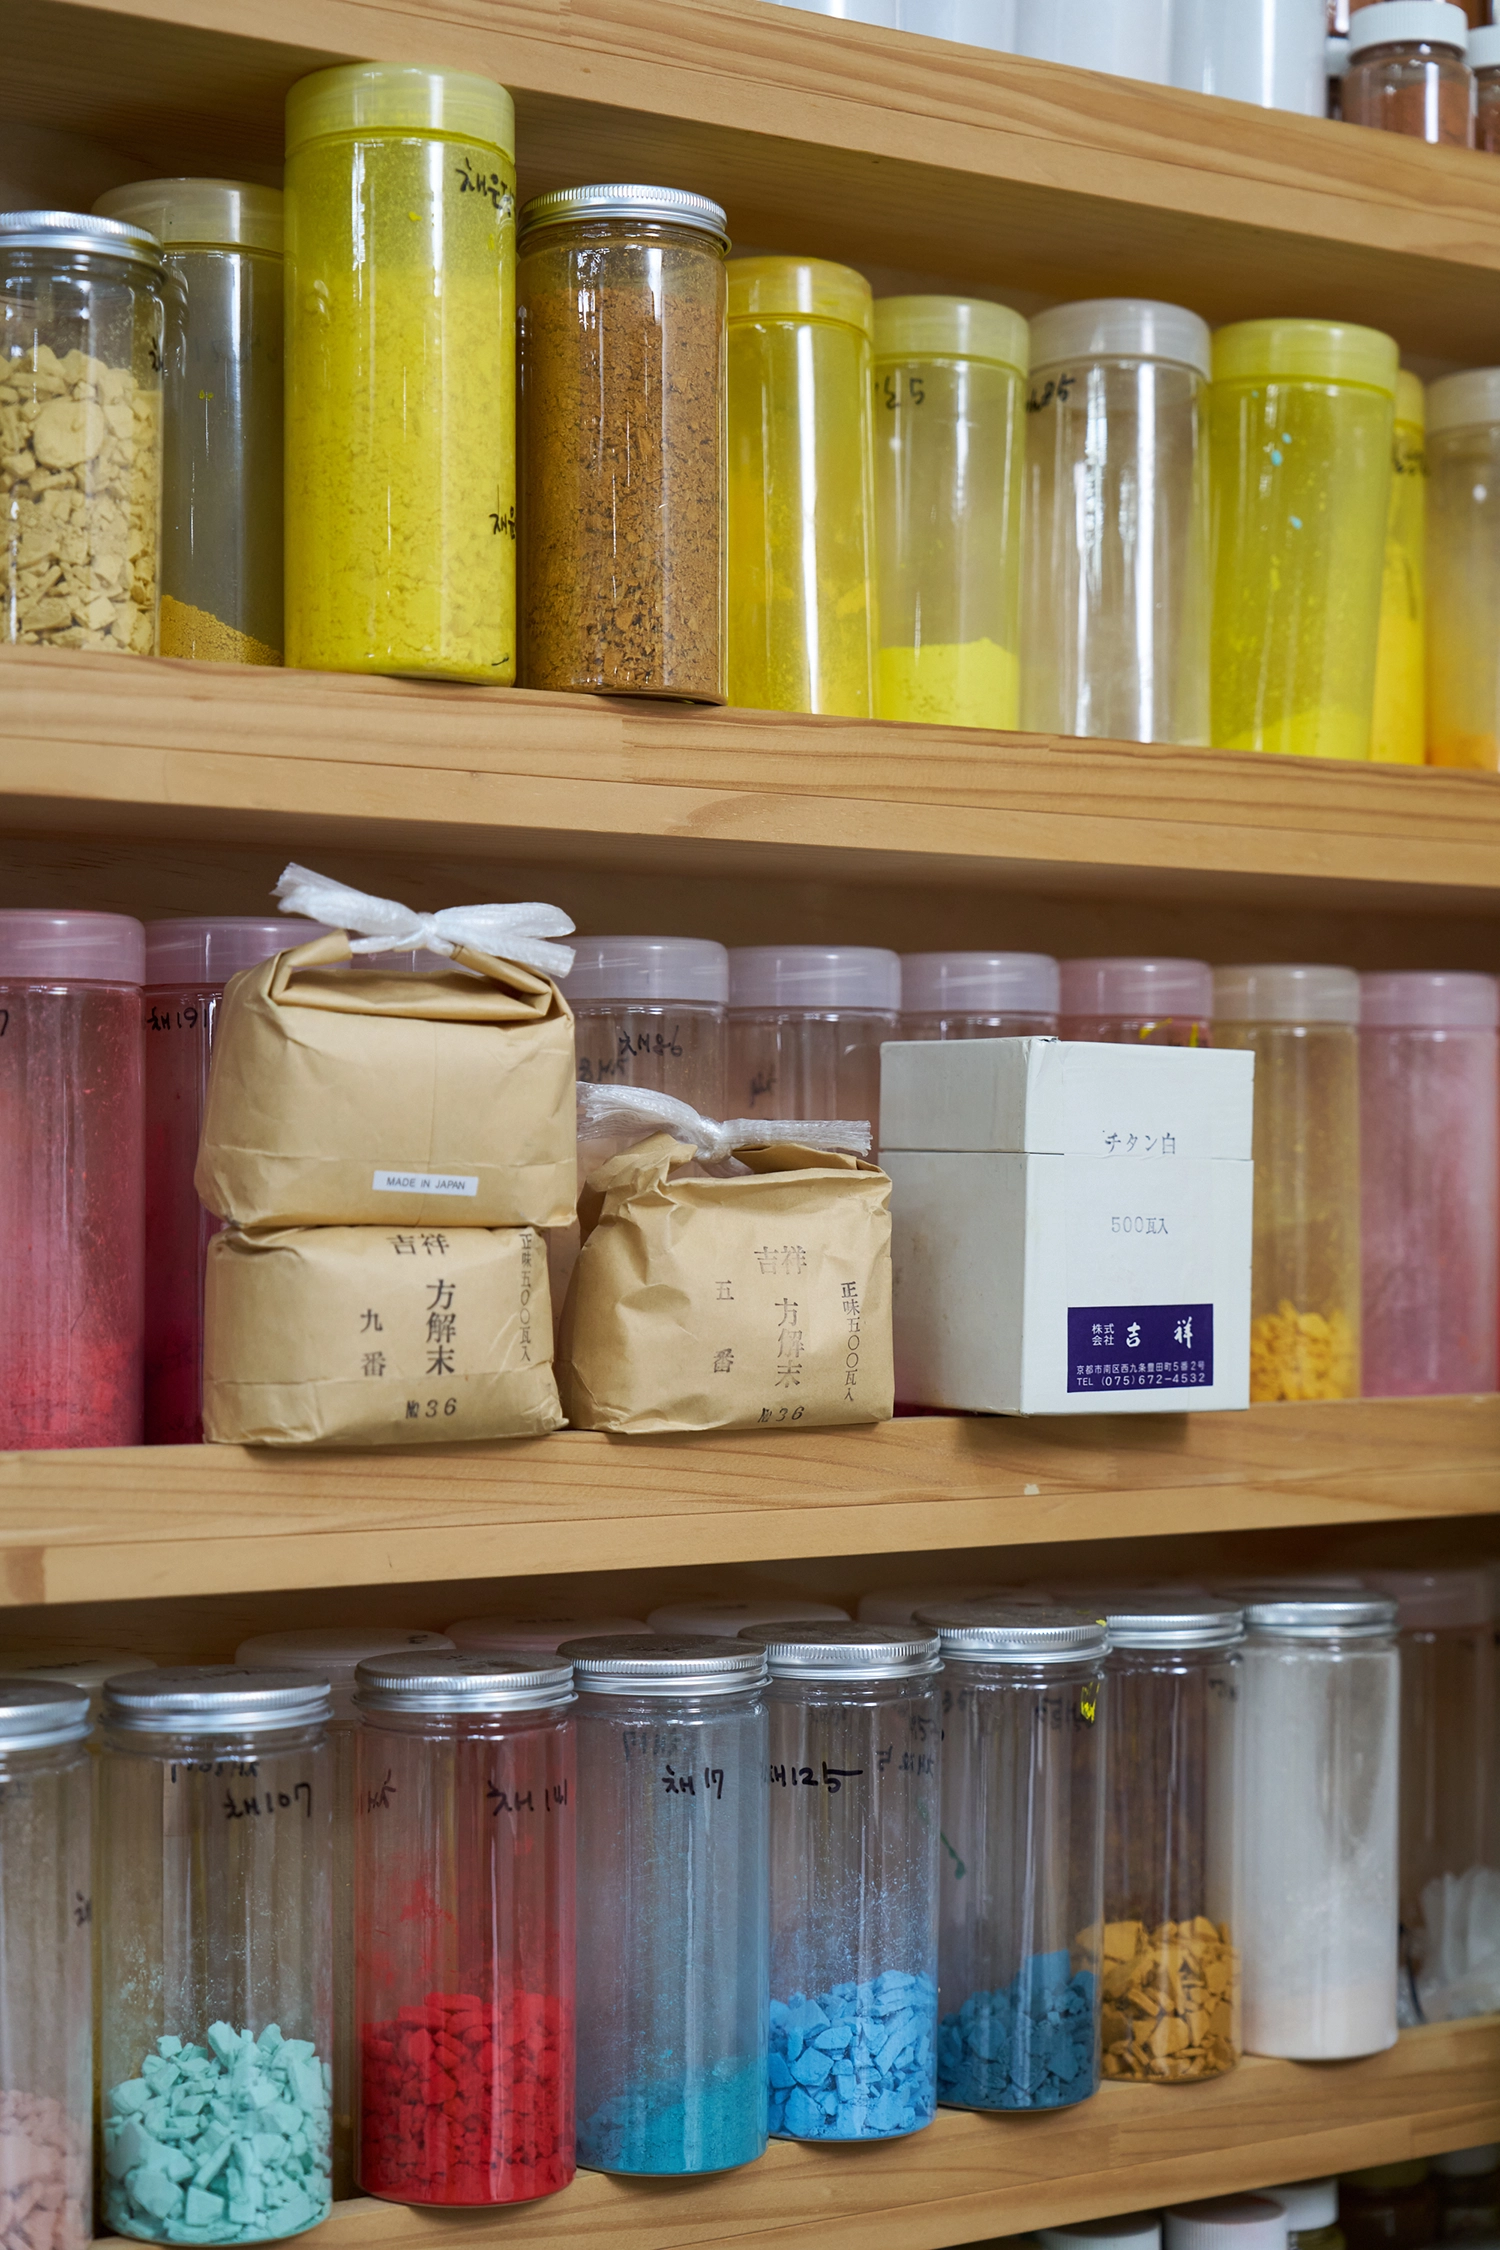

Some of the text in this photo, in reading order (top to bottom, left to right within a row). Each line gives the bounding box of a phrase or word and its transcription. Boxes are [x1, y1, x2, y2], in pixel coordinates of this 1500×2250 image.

[1104, 1132, 1176, 1155] チタン白
[386, 1177, 466, 1190] MADE IN JAPAN
[387, 1233, 450, 1256] 吉祥
[754, 1245, 807, 1275] 吉祥
[426, 1279, 457, 1376] 方解末
[360, 1308, 387, 1378] 九番
[774, 1297, 805, 1389] 方解末
[1077, 1377, 1094, 1387] TEL
